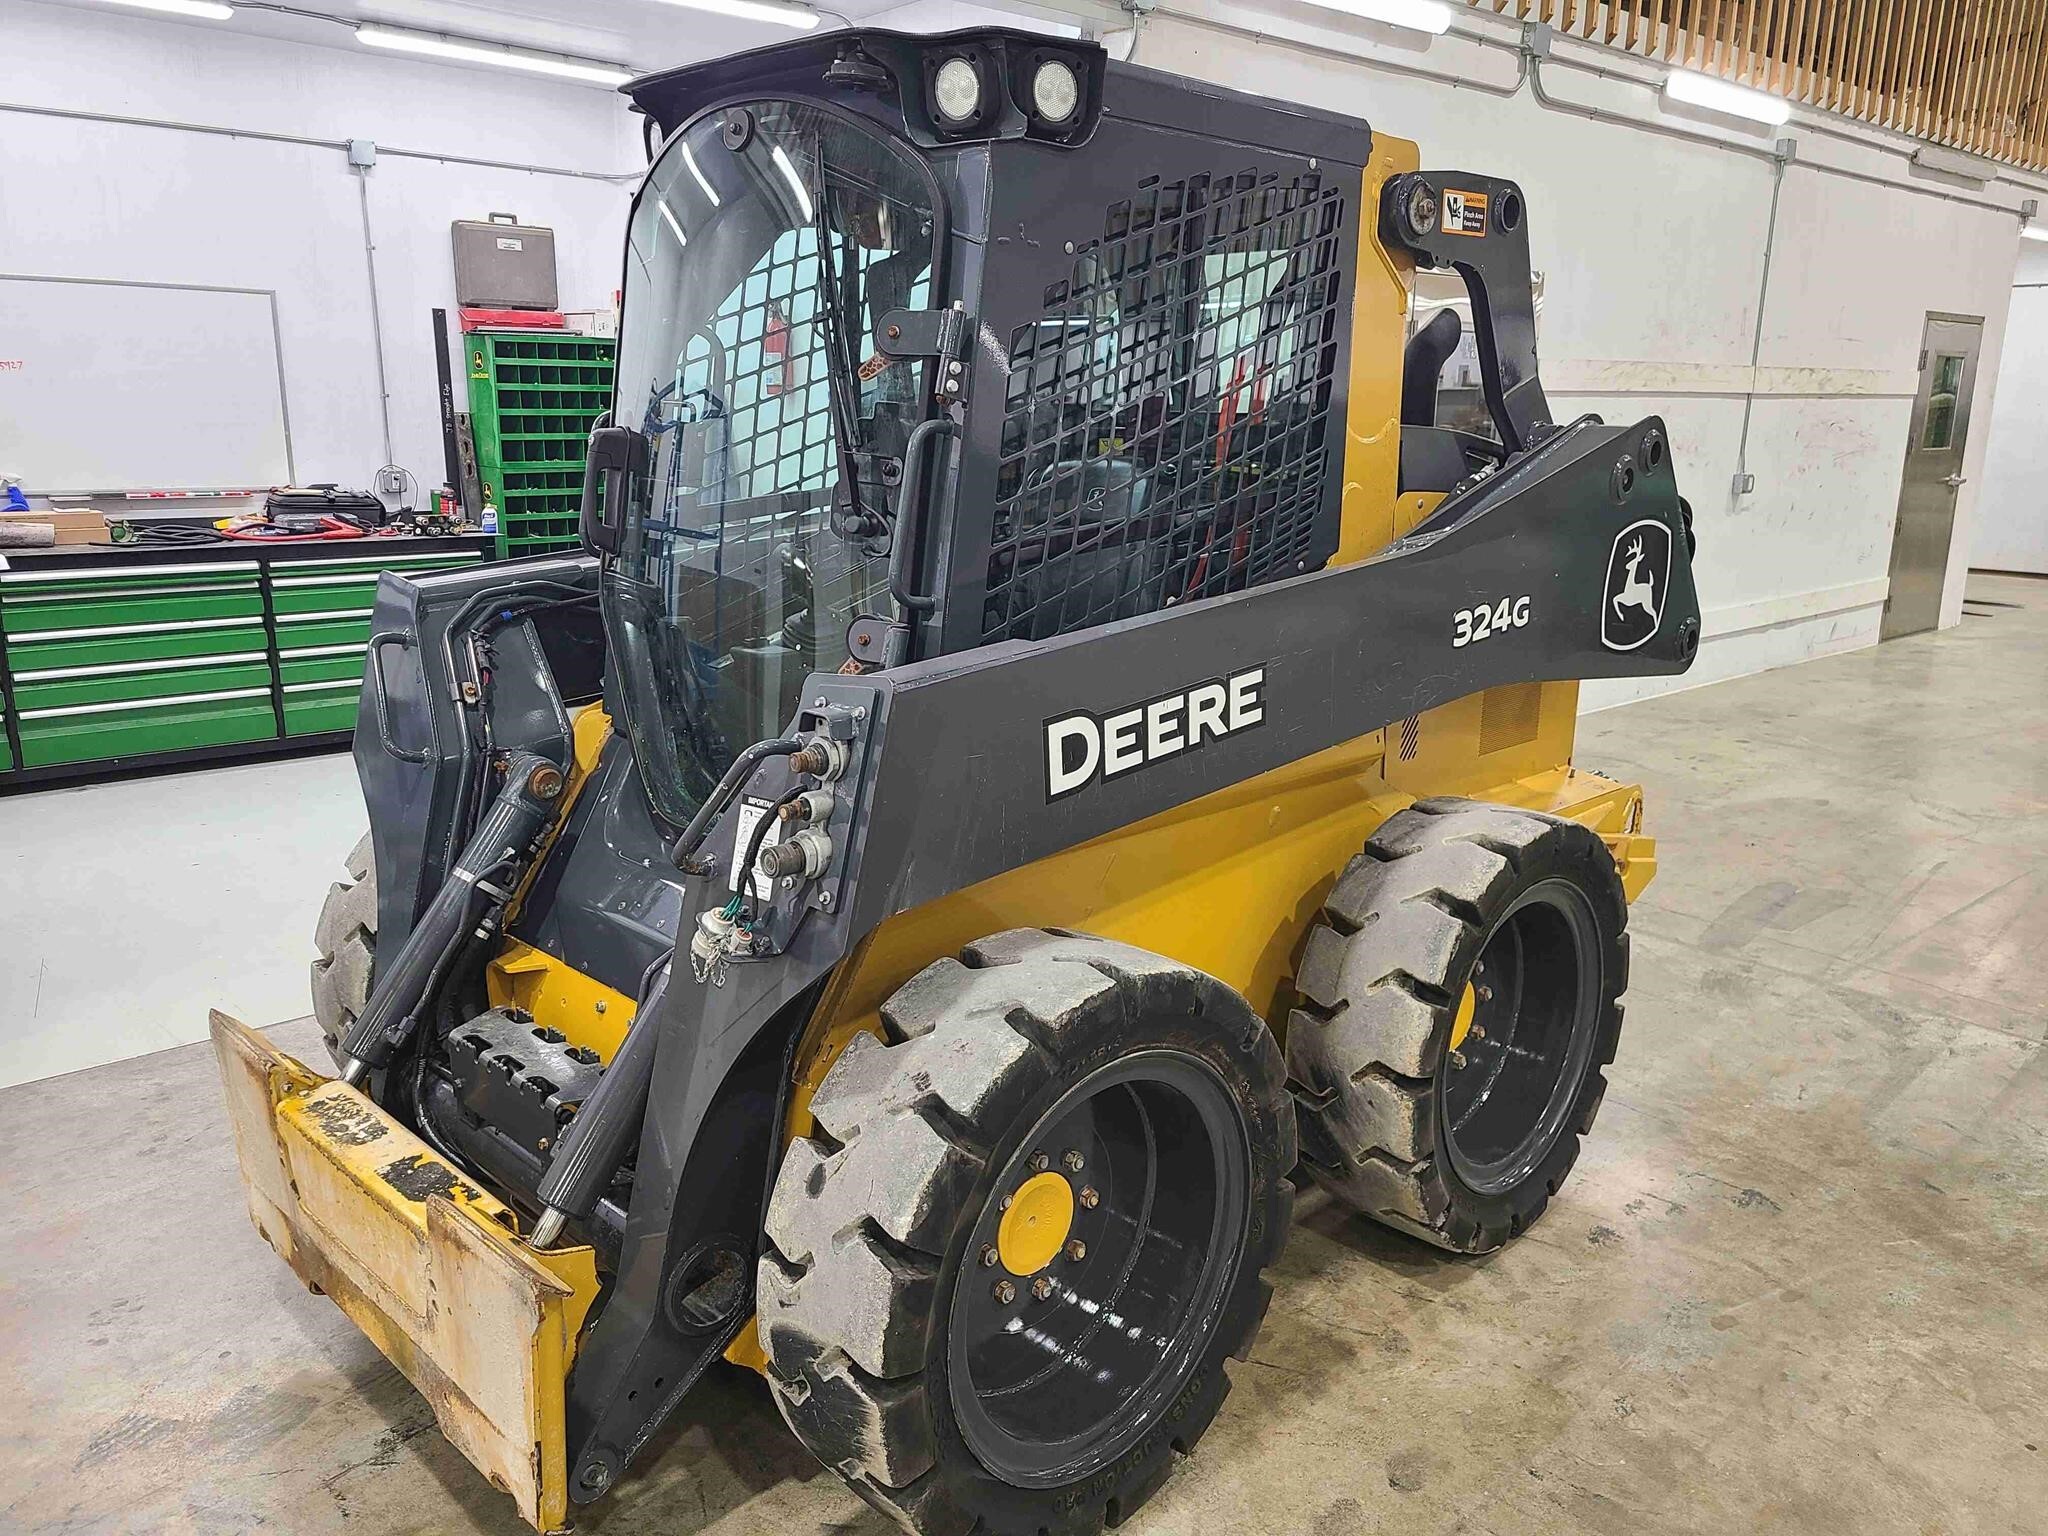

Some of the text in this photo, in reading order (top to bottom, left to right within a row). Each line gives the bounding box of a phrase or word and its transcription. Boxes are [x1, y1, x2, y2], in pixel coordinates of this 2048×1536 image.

[1464, 210, 1484, 220] Pinch Area
[1453, 595, 1530, 647] 324G
[1047, 668, 1264, 796] DEERE
[748, 796, 775, 808] IMPORTAN
